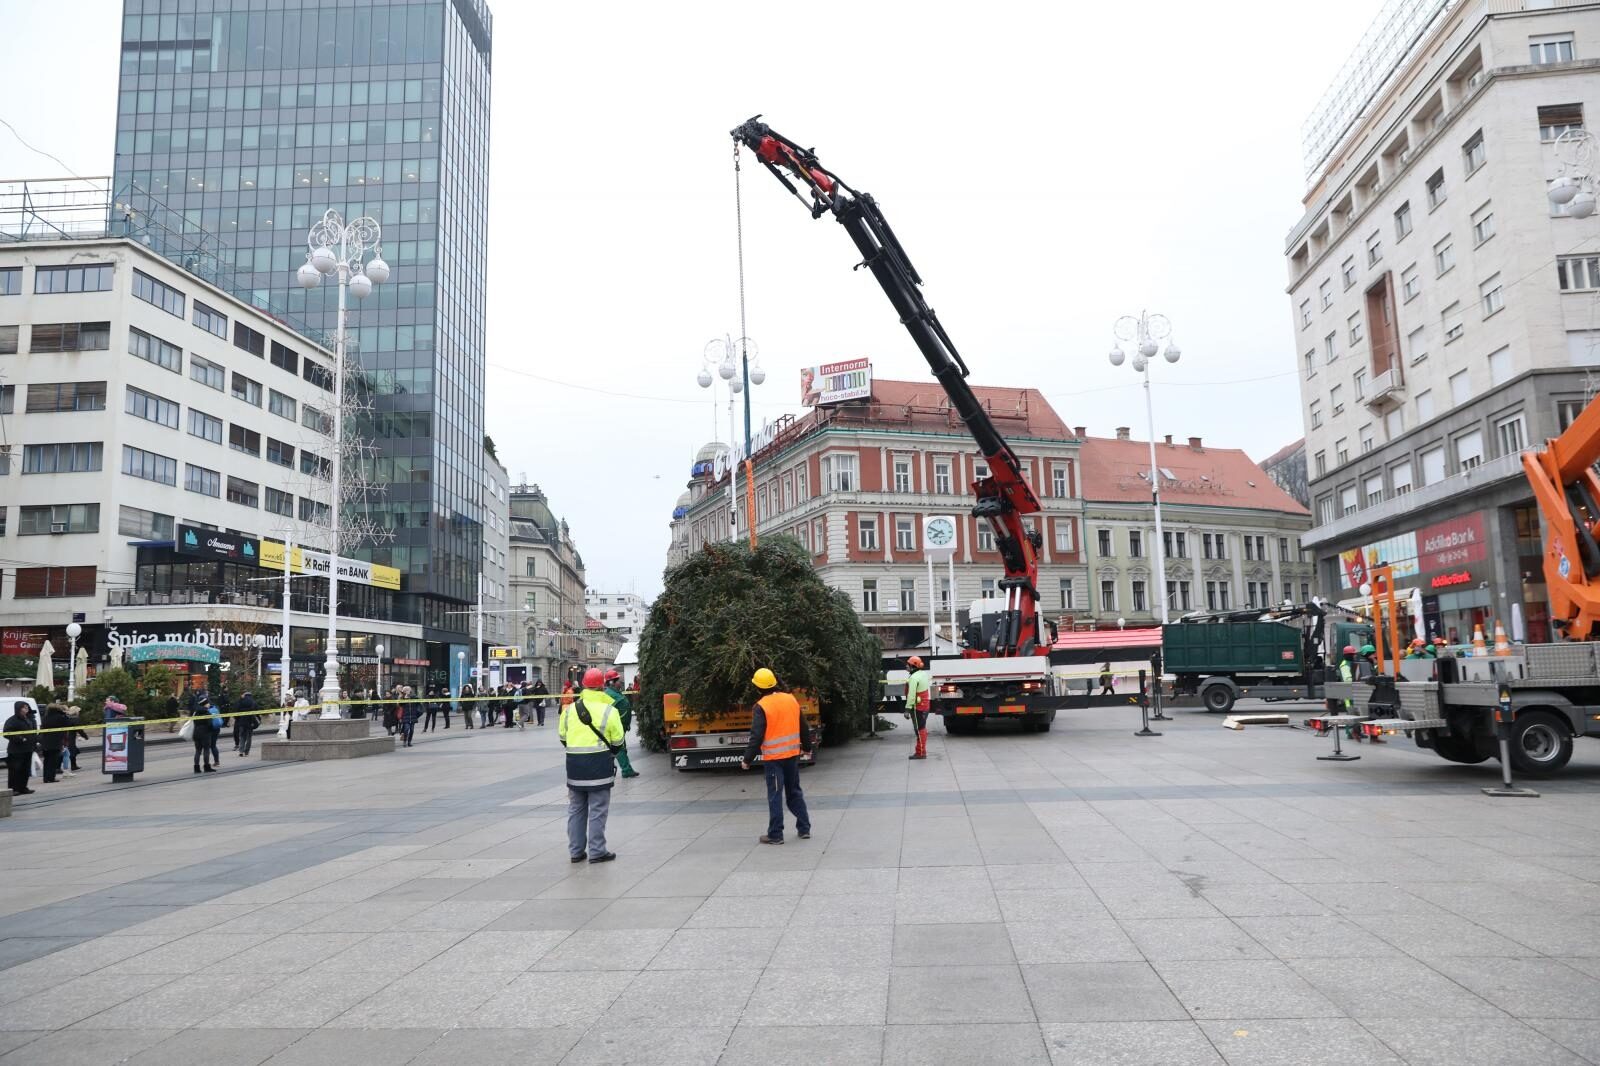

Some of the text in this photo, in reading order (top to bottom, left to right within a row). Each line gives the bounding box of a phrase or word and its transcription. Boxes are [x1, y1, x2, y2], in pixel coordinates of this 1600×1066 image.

[822, 361, 867, 374] Internorm
[312, 559, 347, 576] Raiffsen
[349, 566, 369, 580] BANK
[107, 626, 159, 649] Špica
[165, 628, 243, 648] mobilne
